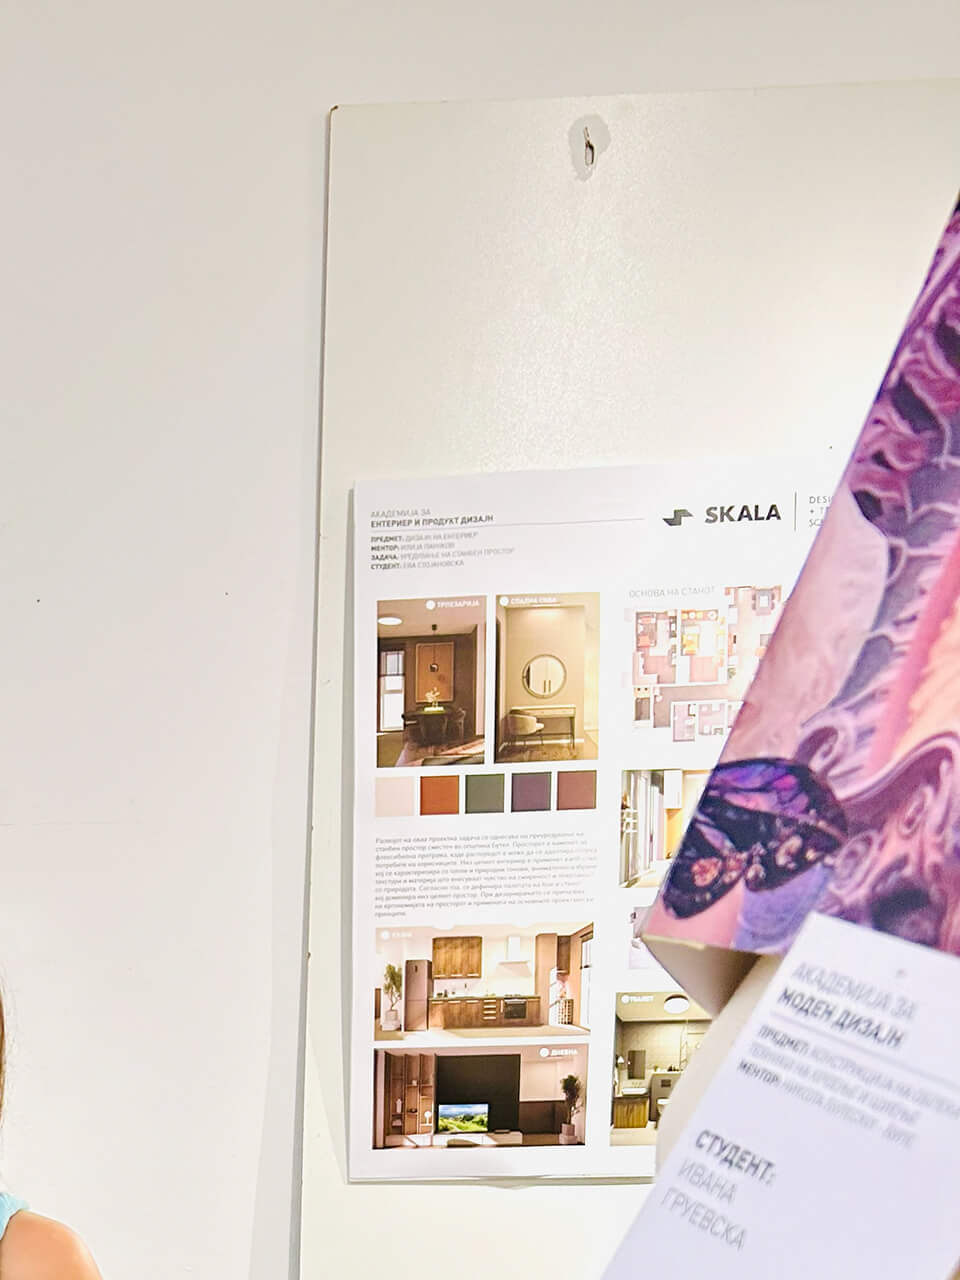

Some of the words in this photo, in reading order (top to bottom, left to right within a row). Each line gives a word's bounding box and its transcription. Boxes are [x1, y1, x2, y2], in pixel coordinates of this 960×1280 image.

[371, 510, 418, 518] АКАДЕМИЈА
[420, 508, 431, 516] ЗА
[371, 519, 412, 528] ЕНТЕРИЕР
[415, 518, 421, 526] И
[422, 517, 458, 526] ПРОДУКТ
[460, 515, 494, 524] ДИЗАЈН
[705, 504, 781, 523] SKALA
[792, 962, 888, 1011] АКАДЕМИЈА
[777, 987, 834, 1020] МОДЕН
[835, 1008, 904, 1048] ДИЗАЈН
[679, 1158, 737, 1205] ИВАНА
[695, 1130, 776, 1186] СТУДЕНТ:
[661, 1187, 746, 1250] ГРУЕВСКА
